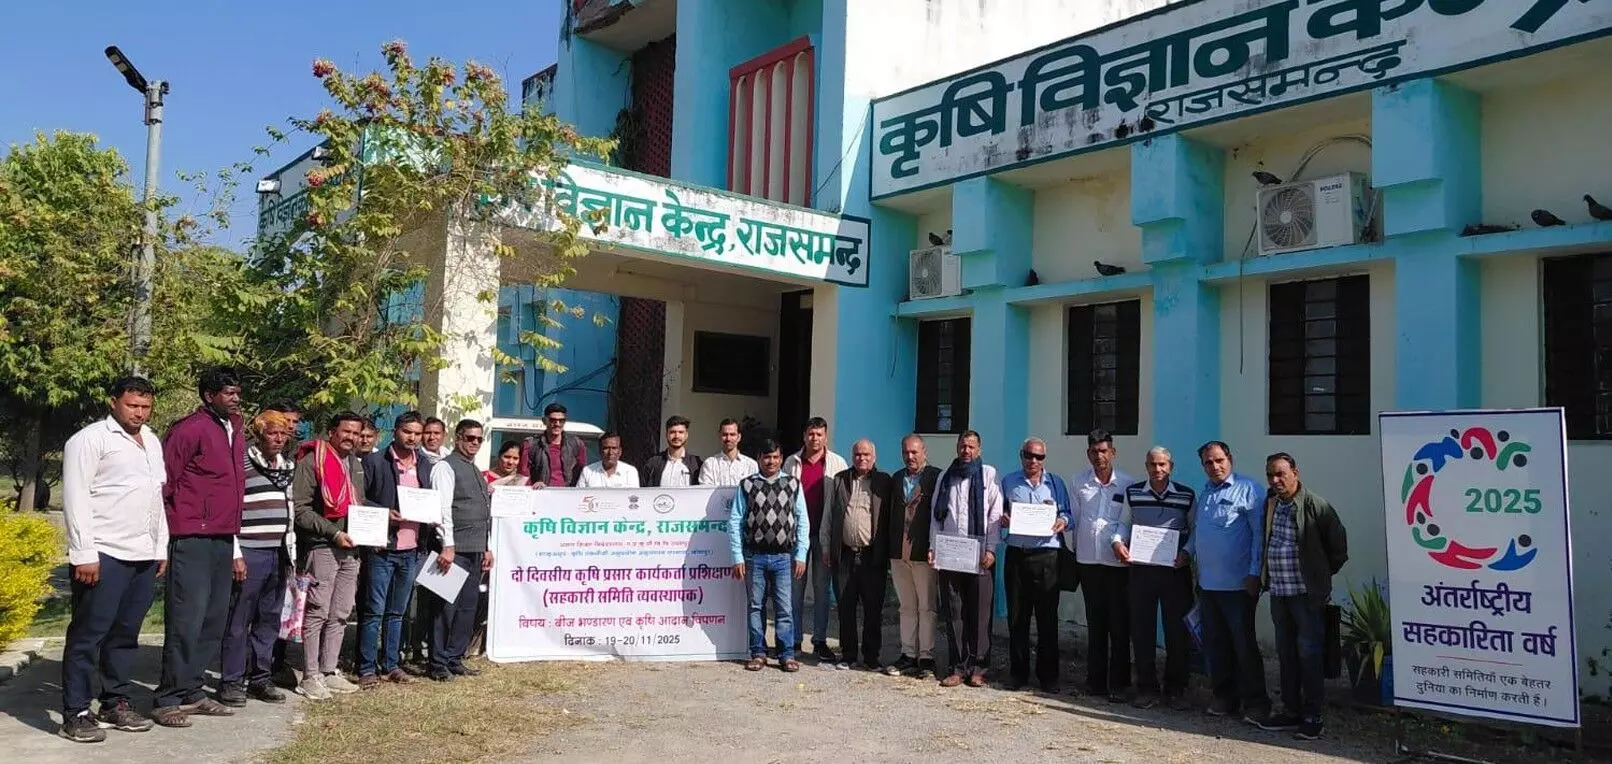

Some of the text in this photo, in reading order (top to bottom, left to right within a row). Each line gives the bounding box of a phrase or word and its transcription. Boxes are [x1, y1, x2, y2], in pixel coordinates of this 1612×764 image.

[880, 1, 1300, 178] कृषि विज्ञान
[1147, 39, 1407, 124] राजसमन्द
[737, 216, 863, 275] राजसमन्द
[1464, 487, 1542, 514] 2025
[522, 517, 557, 539] कृषि
[560, 517, 609, 534] विज्ञान
[511, 566, 524, 582] दो
[526, 566, 572, 582] दिवसीय
[575, 565, 601, 585] कृषि
[603, 568, 632, 581] प्रसार
[635, 564, 685, 581] कार्यकर्ता
[543, 586, 704, 608] (सहकारी समिति व्यवस्थापक)
[1421, 579, 1532, 617] अंतर्राष्ट्रीय
[519, 614, 545, 628] विषय
[554, 614, 576, 627] बीज
[578, 616, 616, 627] भण्डारण
[635, 612, 656, 630] कृषि
[659, 615, 689, 626] आदान
[691, 611, 725, 625] विपणन
[564, 632, 596, 646] दिनांक
[605, 634, 681, 647] 19-20/11/2025
[1402, 620, 1558, 657] सहकारिता वर्ष
[1412, 664, 1450, 678] सहकारी
[1499, 674, 1518, 687] एक
[1520, 675, 1552, 690] बेहतर
[1416, 681, 1446, 695] दुनिया
[1448, 685, 1461, 696] का
[1465, 684, 1498, 701] निर्माण
[1500, 690, 1530, 705] करती
